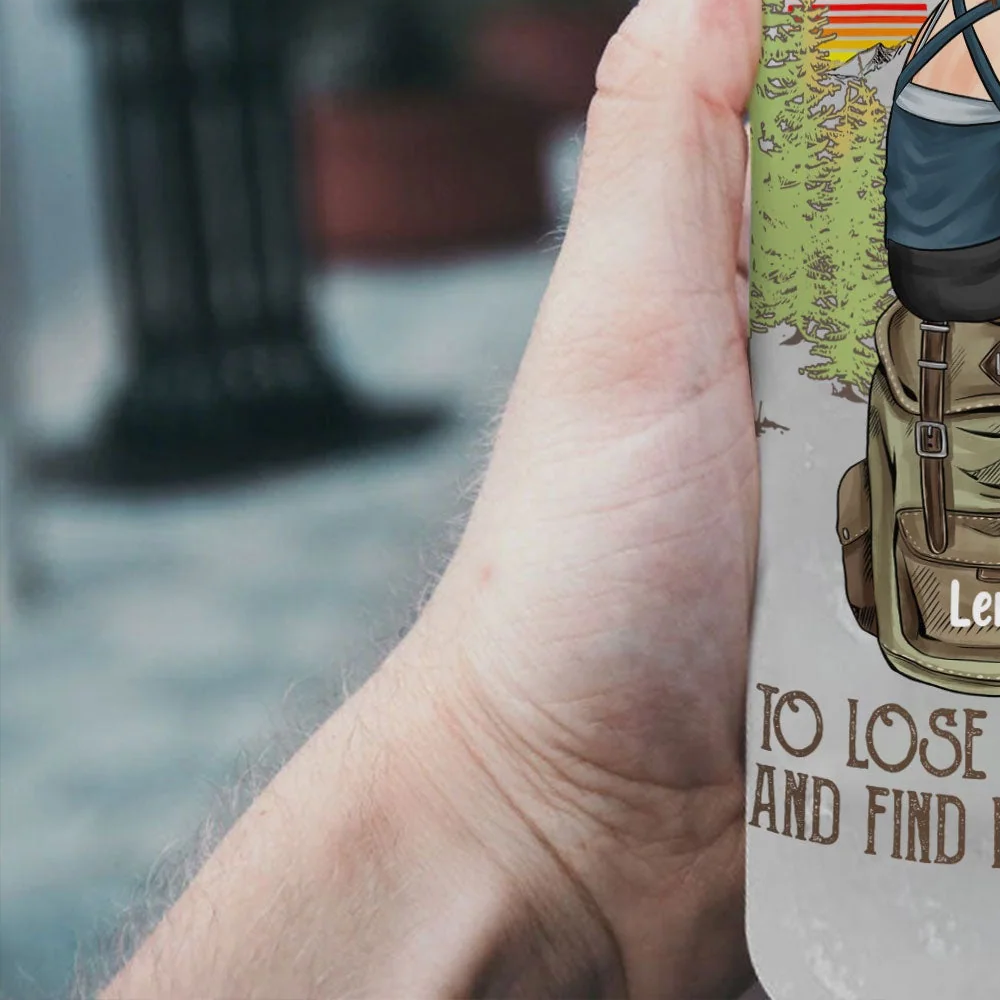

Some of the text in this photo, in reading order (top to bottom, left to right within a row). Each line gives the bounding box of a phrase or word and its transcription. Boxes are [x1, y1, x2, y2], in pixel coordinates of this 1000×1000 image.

[756, 682, 823, 758] TO
[846, 698, 987, 780] LOSE
[748, 763, 840, 845] AND
[863, 785, 966, 865] FIND
